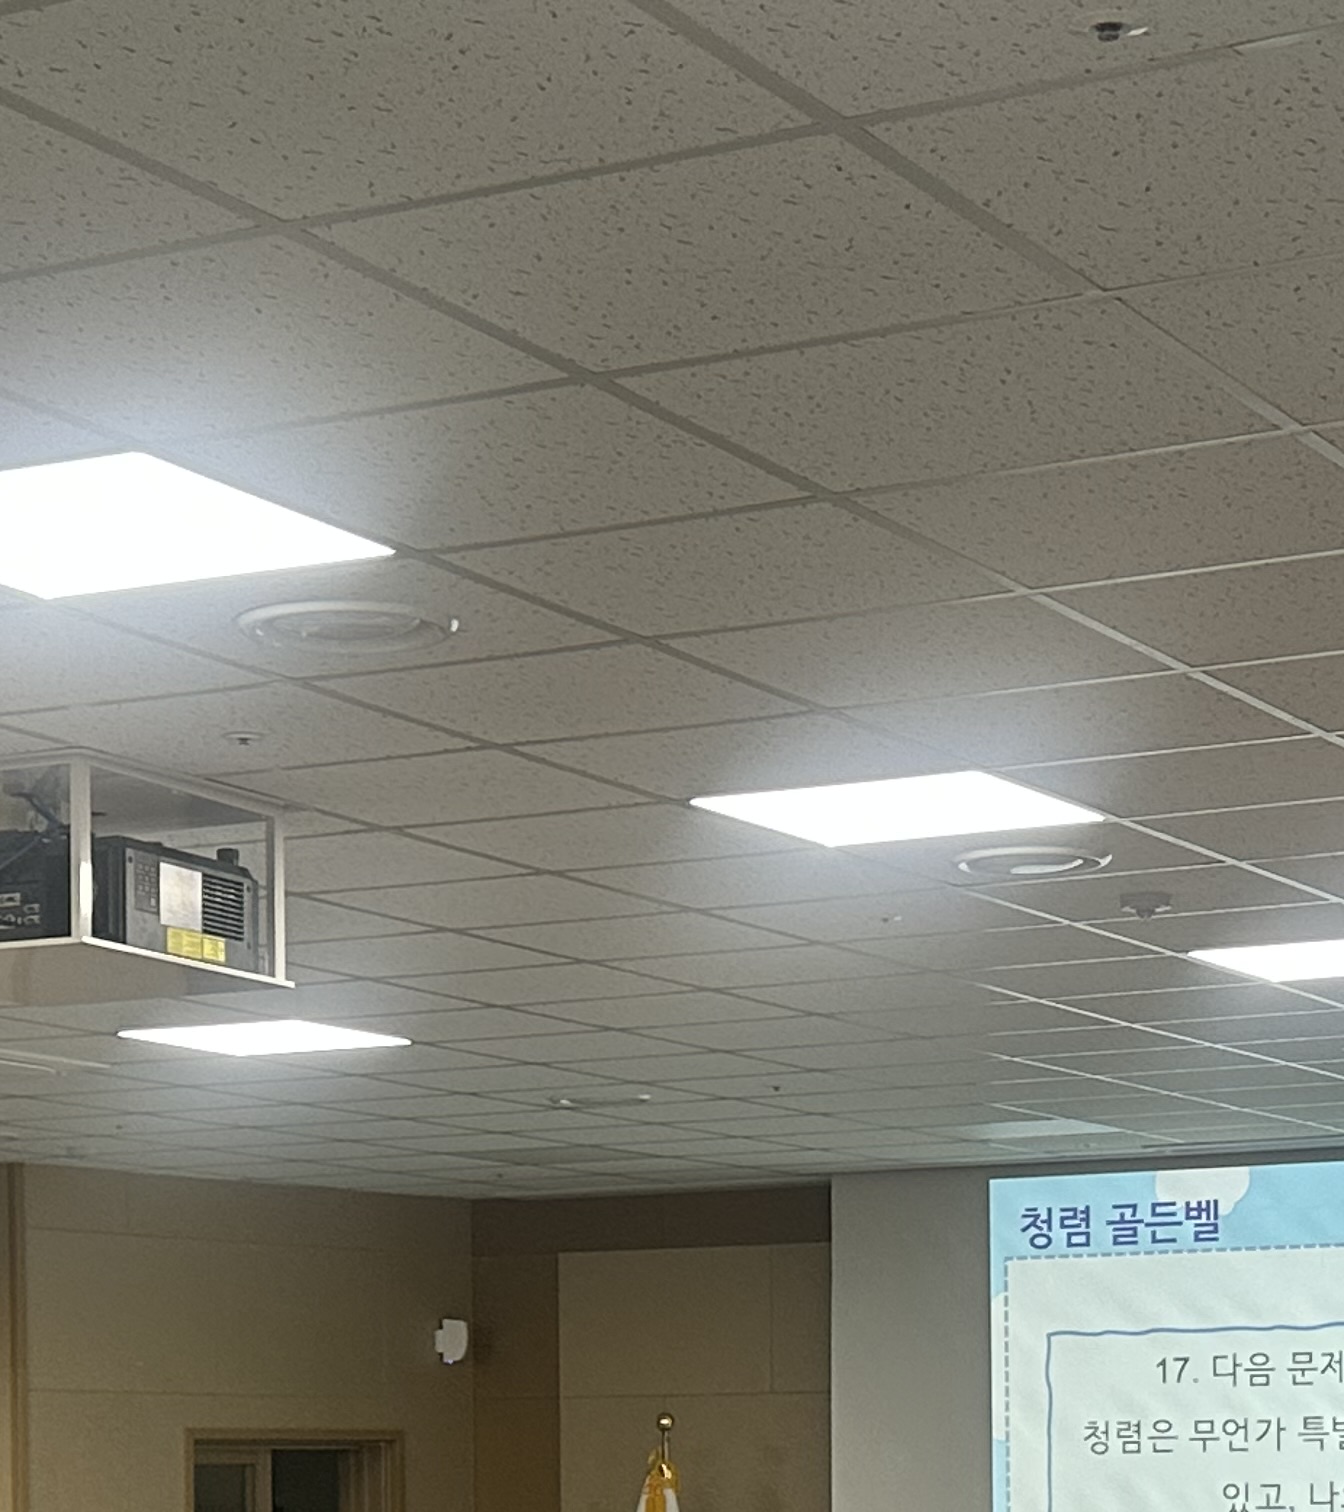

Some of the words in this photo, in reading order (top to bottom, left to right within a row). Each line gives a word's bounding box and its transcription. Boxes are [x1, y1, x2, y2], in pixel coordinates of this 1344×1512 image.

[1018, 1203, 1093, 1252] 청렴
[1105, 1199, 1221, 1244] 골든벨
[1154, 1355, 1201, 1386] 17.
[1211, 1350, 1278, 1389] 다음
[1081, 1417, 1181, 1457] 청렴은
[1187, 1415, 1288, 1455] 무언가
